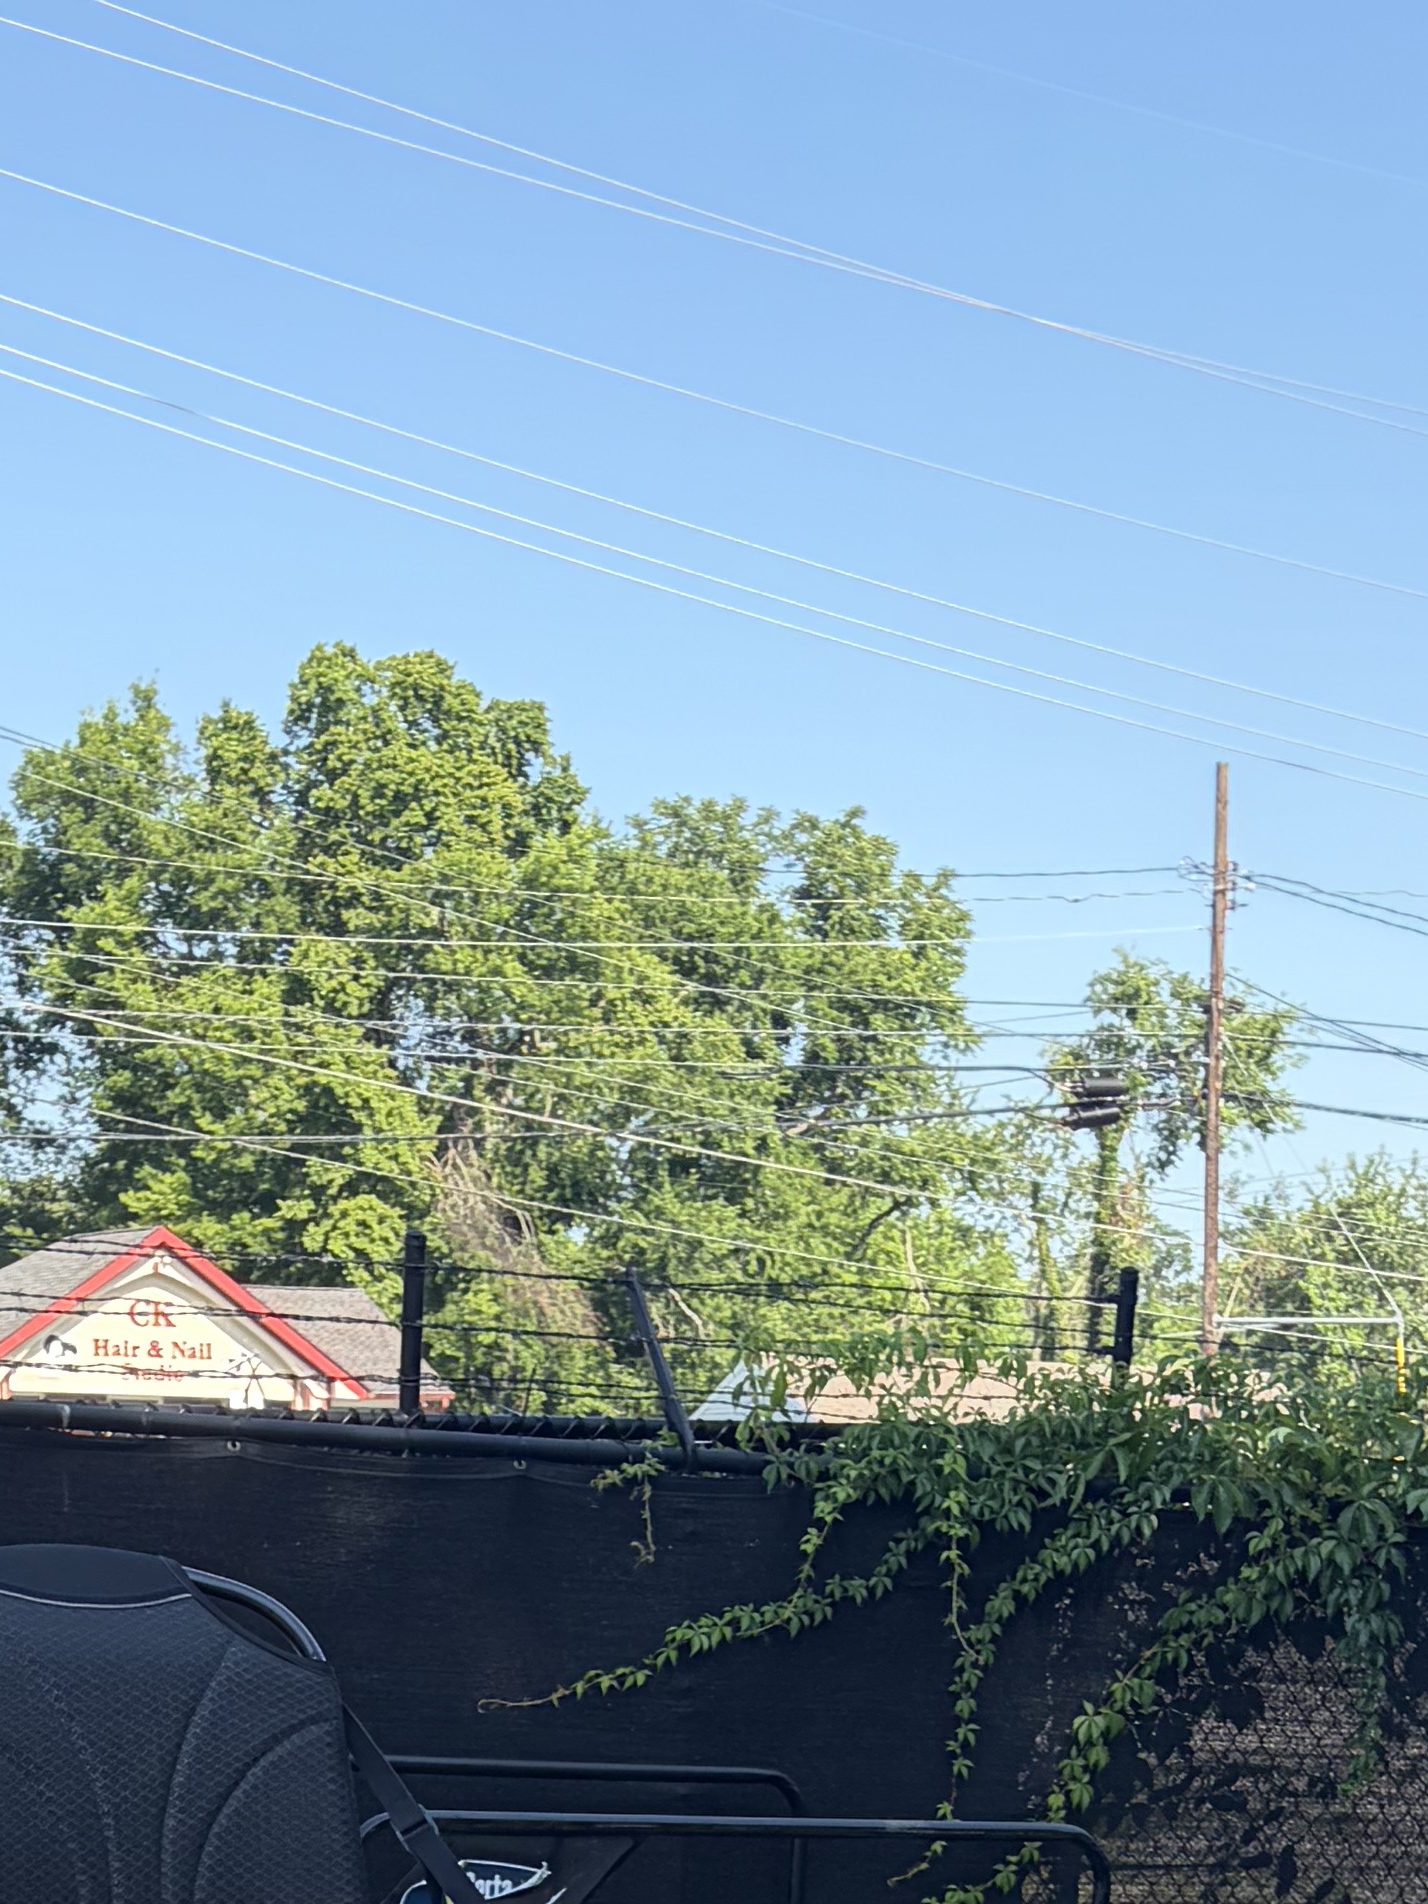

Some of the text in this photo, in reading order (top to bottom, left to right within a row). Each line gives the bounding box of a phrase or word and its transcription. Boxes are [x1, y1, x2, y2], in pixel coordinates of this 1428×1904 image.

[129, 1300, 176, 1327] CK
[92, 1338, 212, 1360] Hair & Nail
